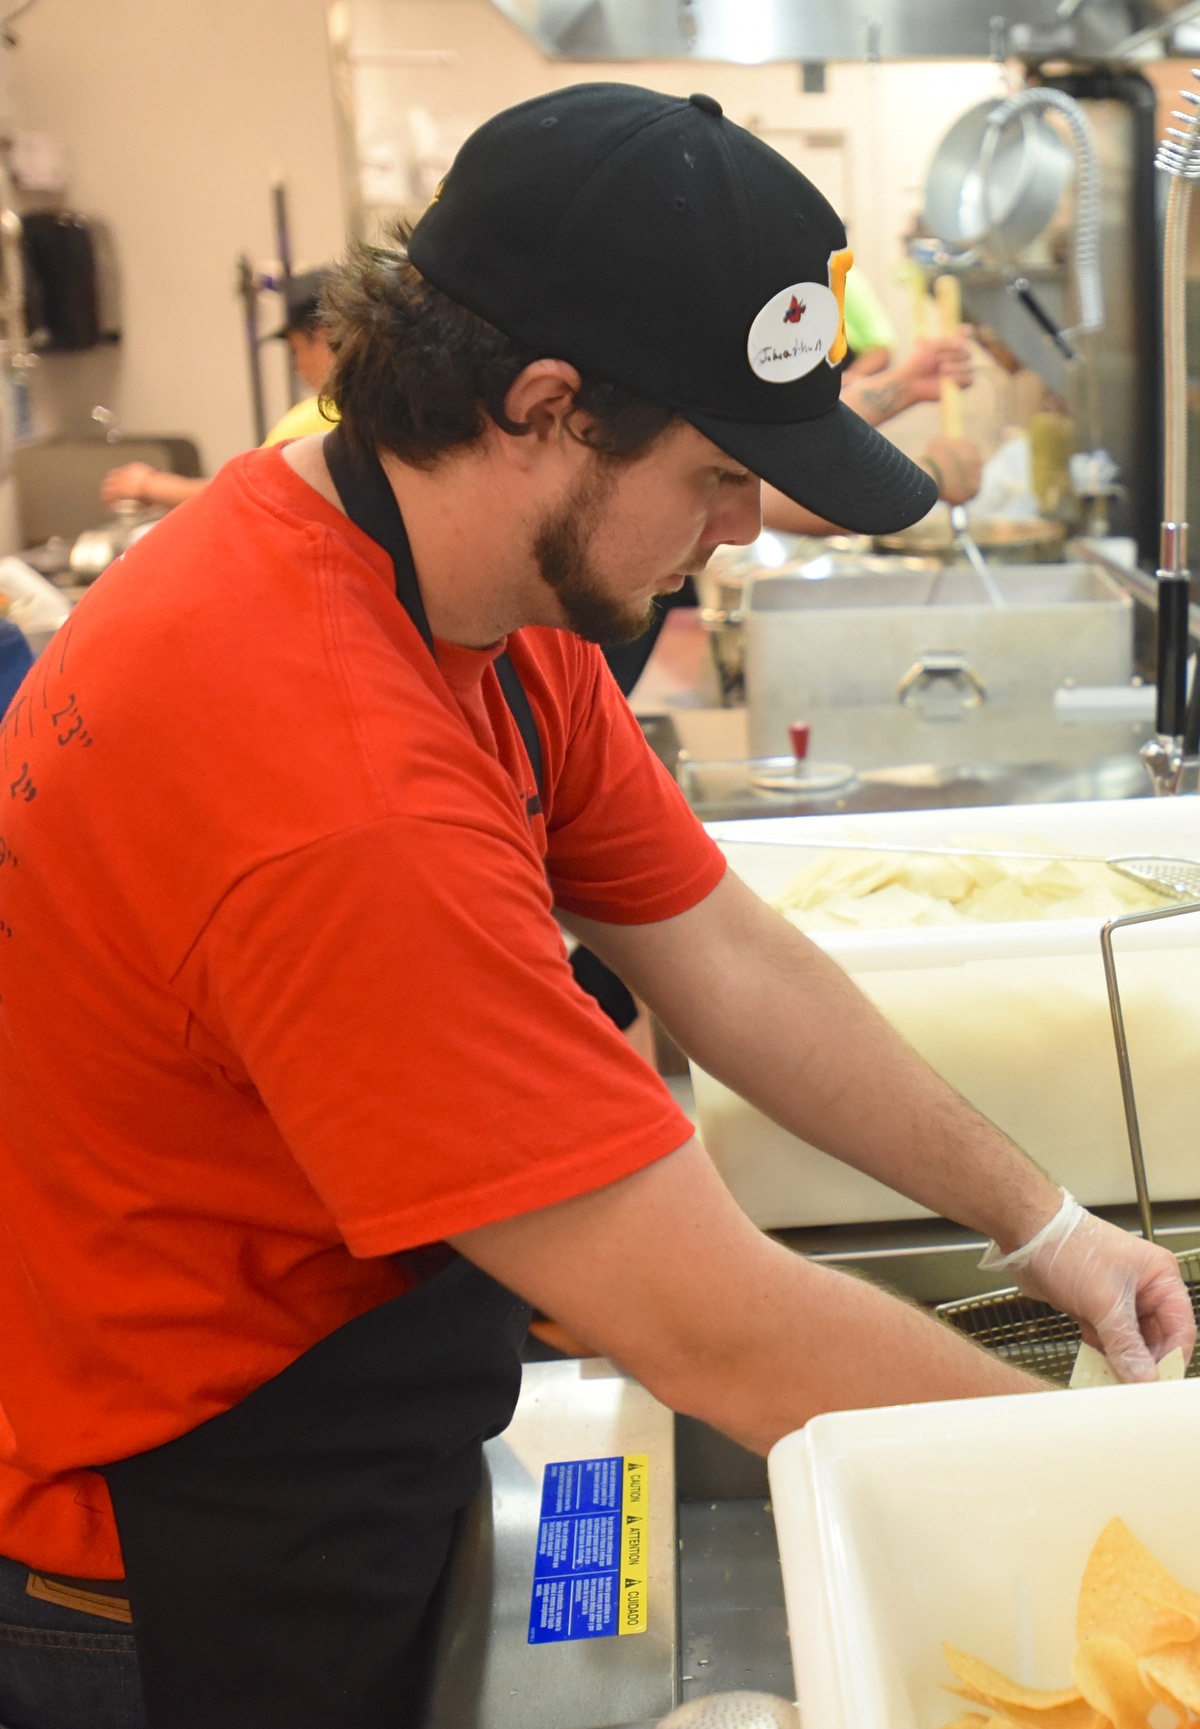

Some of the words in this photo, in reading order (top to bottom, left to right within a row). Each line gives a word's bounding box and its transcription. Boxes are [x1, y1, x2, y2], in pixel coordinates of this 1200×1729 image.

[629, 1474, 642, 1503] CAUTION
[627, 1527, 641, 1566] ATTENTION
[626, 1591, 640, 1627] CUIDADO
